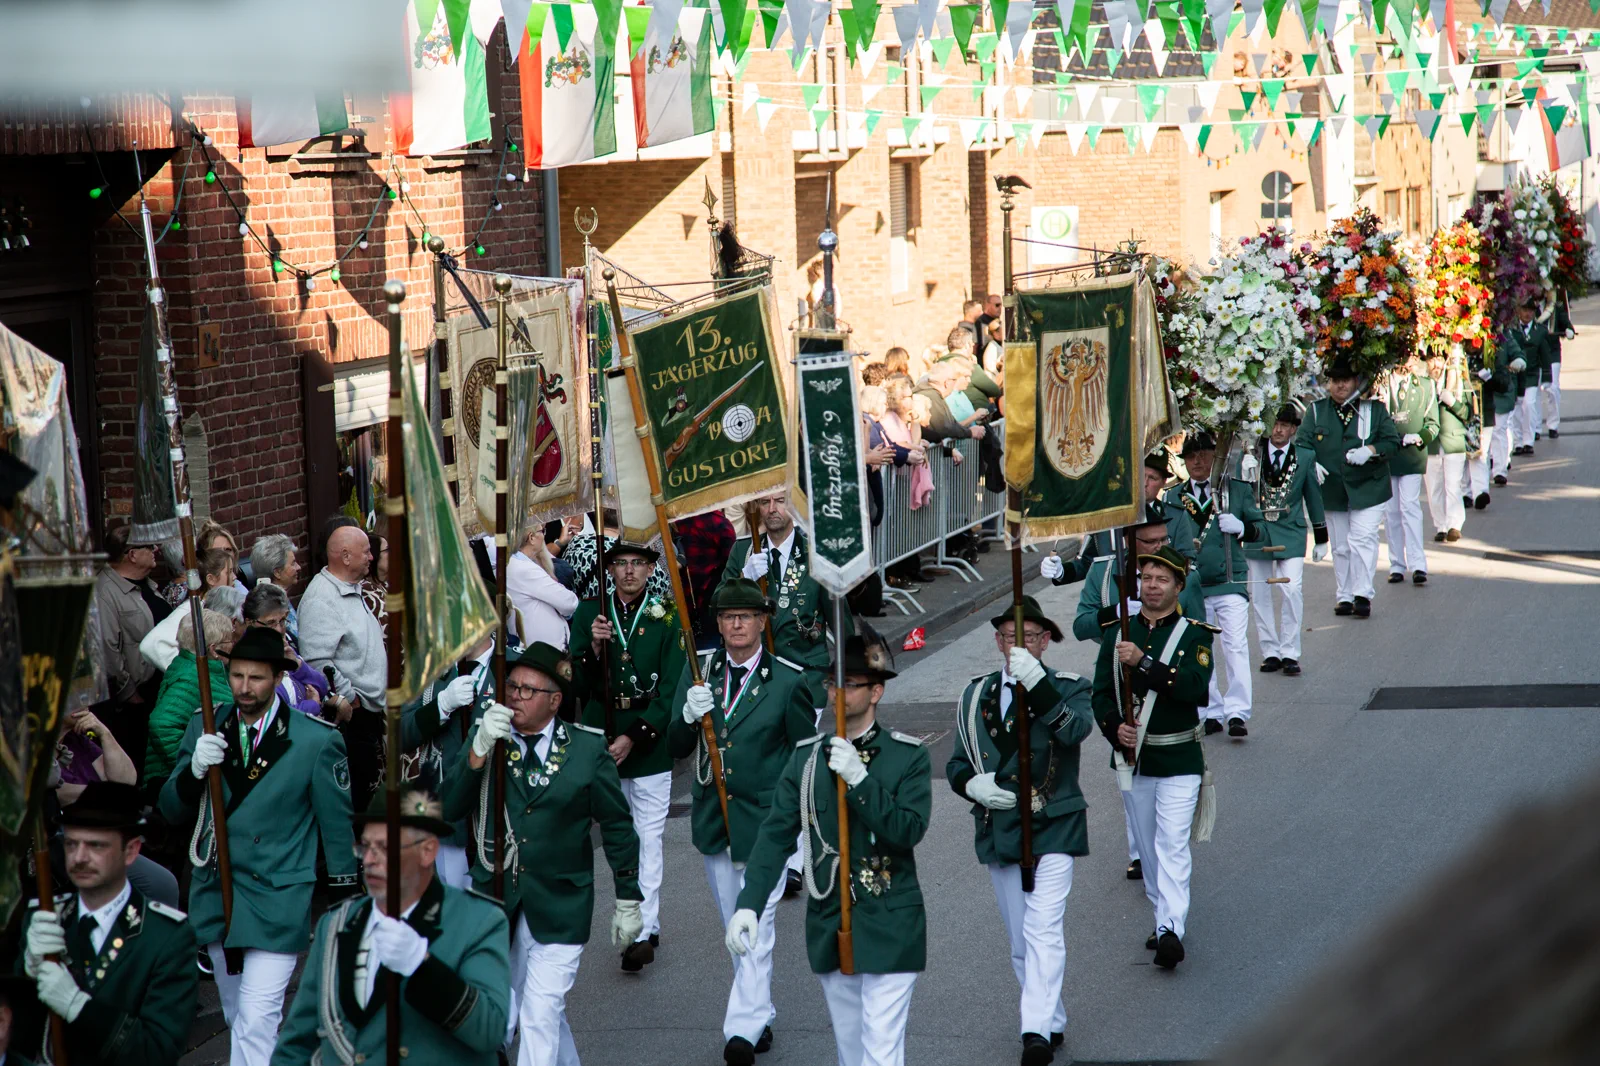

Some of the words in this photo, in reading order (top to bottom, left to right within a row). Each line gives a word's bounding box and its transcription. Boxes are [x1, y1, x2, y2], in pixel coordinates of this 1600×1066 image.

[1049, 213, 1062, 234] H
[676, 315, 732, 358] 13.
[649, 341, 758, 391] JÄGERZUG
[705, 421, 722, 441] 19
[756, 405, 772, 427] 74
[823, 410, 842, 427] 6.
[667, 438, 778, 488] GUSTORF
[819, 430, 844, 520] Jägerzug
